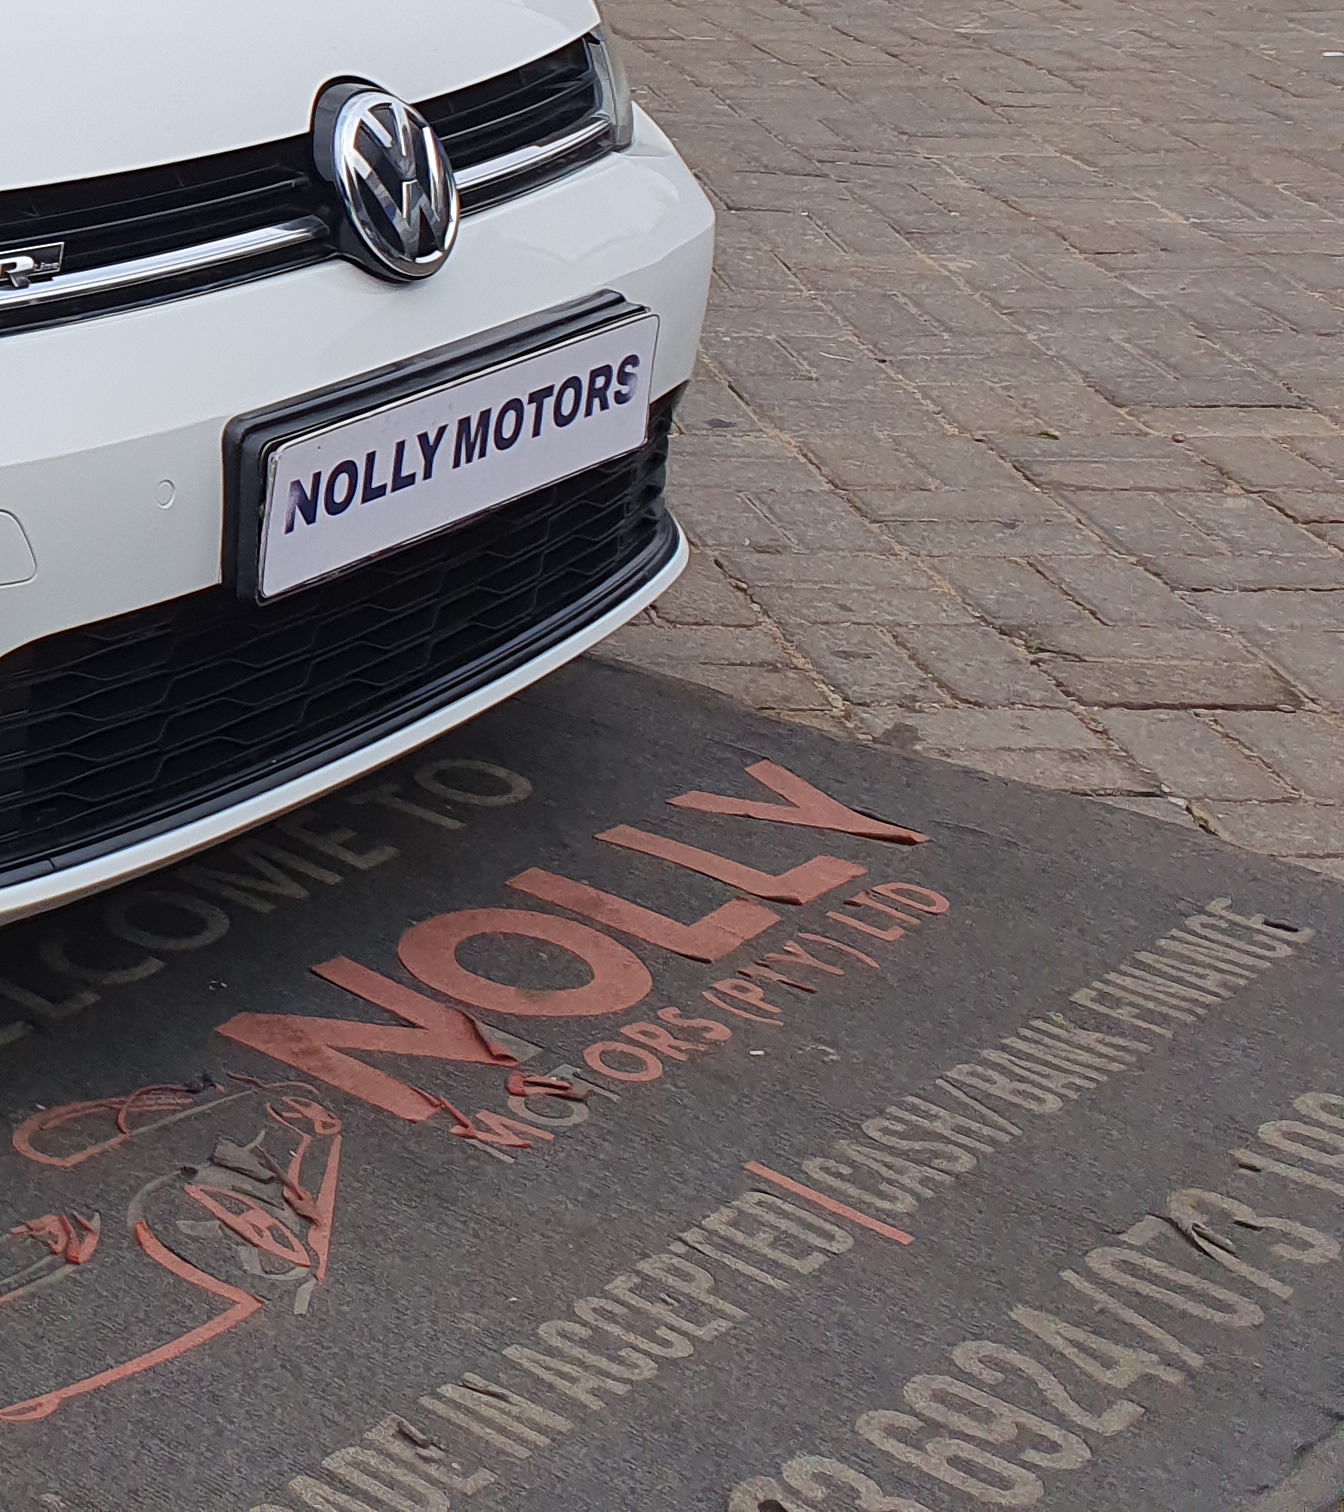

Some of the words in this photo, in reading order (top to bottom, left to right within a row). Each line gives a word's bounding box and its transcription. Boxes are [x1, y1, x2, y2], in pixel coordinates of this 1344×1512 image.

[284, 423, 449, 534] NOLLY
[452, 354, 641, 469] MOTORS
[348, 758, 533, 831] TO
[215, 758, 930, 1122] NOLLY
[450, 1006, 732, 1163] MOTORS
[826, 882, 950, 941] LTD
[418, 1372, 574, 1460] IN
[502, 1190, 854, 1410] ACCEPTED
[1069, 897, 1315, 1038] FINANCE
